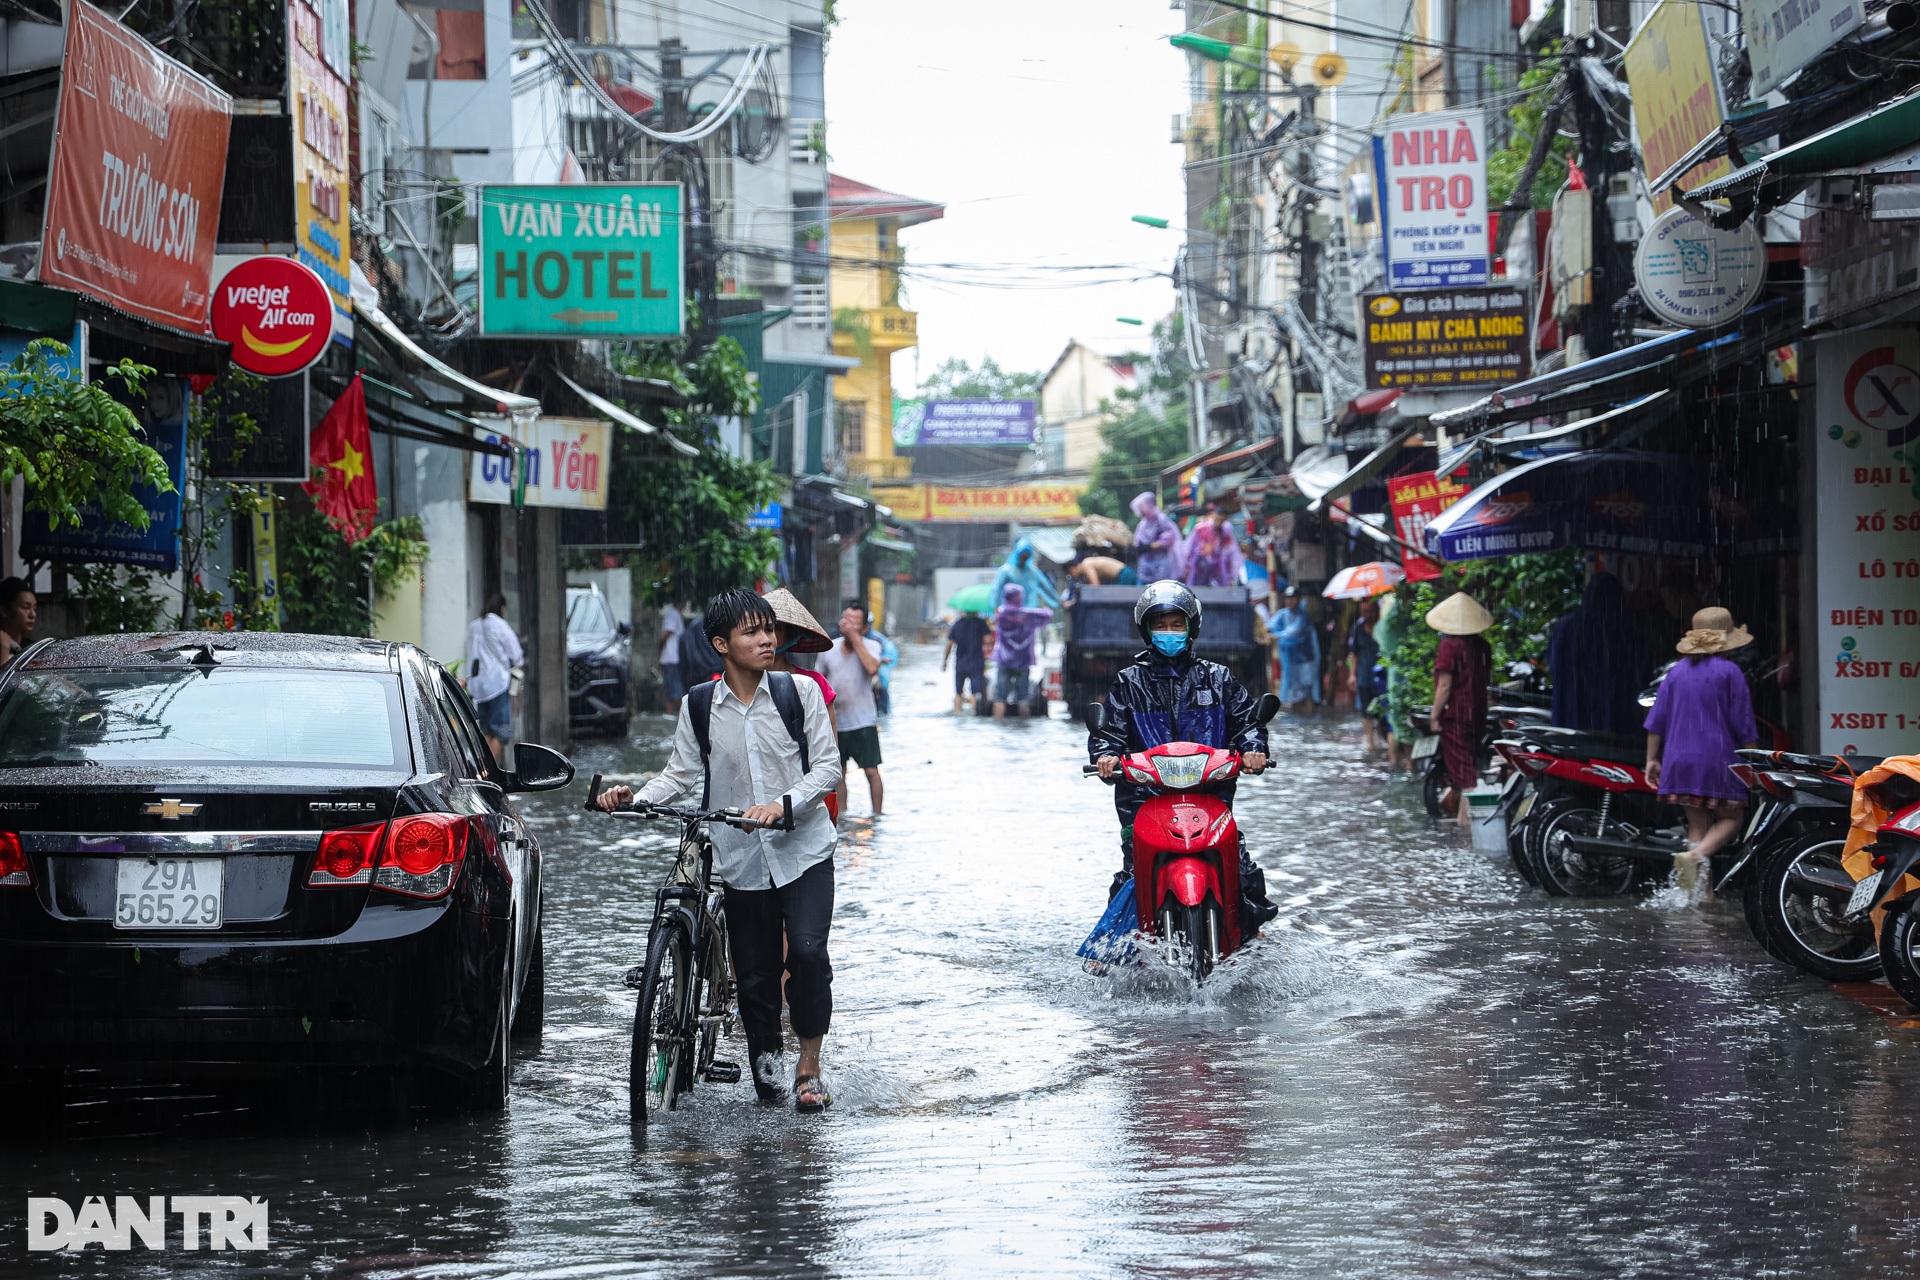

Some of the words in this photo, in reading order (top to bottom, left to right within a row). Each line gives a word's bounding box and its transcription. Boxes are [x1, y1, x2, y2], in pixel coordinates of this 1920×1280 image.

[1392, 121, 1478, 166] NHÀ
[100, 150, 166, 254] TRƯỜNG
[165, 182, 199, 265] SƠN
[1396, 173, 1473, 218] TRỌ
[497, 202, 564, 243] VẠN
[574, 194, 662, 238] XUÂN
[1393, 224, 1430, 238] PHÒNG
[1432, 222, 1461, 237] KHÉP
[494, 250, 668, 299] HOTEL
[1370, 317, 1413, 343] BÁNH
[1444, 313, 1477, 339] CHẢ
[1479, 311, 1525, 337] NÓNG
[551, 433, 599, 492] Yến
[1853, 467, 1892, 487] ĐẠI
[1488, 500, 1529, 518] 789
[1455, 534, 1482, 553] LIÊN
[1485, 532, 1517, 551] MINH
[1519, 531, 1555, 548] OKVIP
[1859, 558, 1886, 579] LÔ
[1893, 558, 1920, 579] TÔ
[1831, 606, 1884, 629] ĐIỆN
[1891, 609, 1920, 626] TO
[1835, 661, 1893, 678] XSĐT
[1830, 713, 1888, 729] XSĐT
[141, 860, 197, 892] 29A
[118, 893, 219, 925] 565.29
